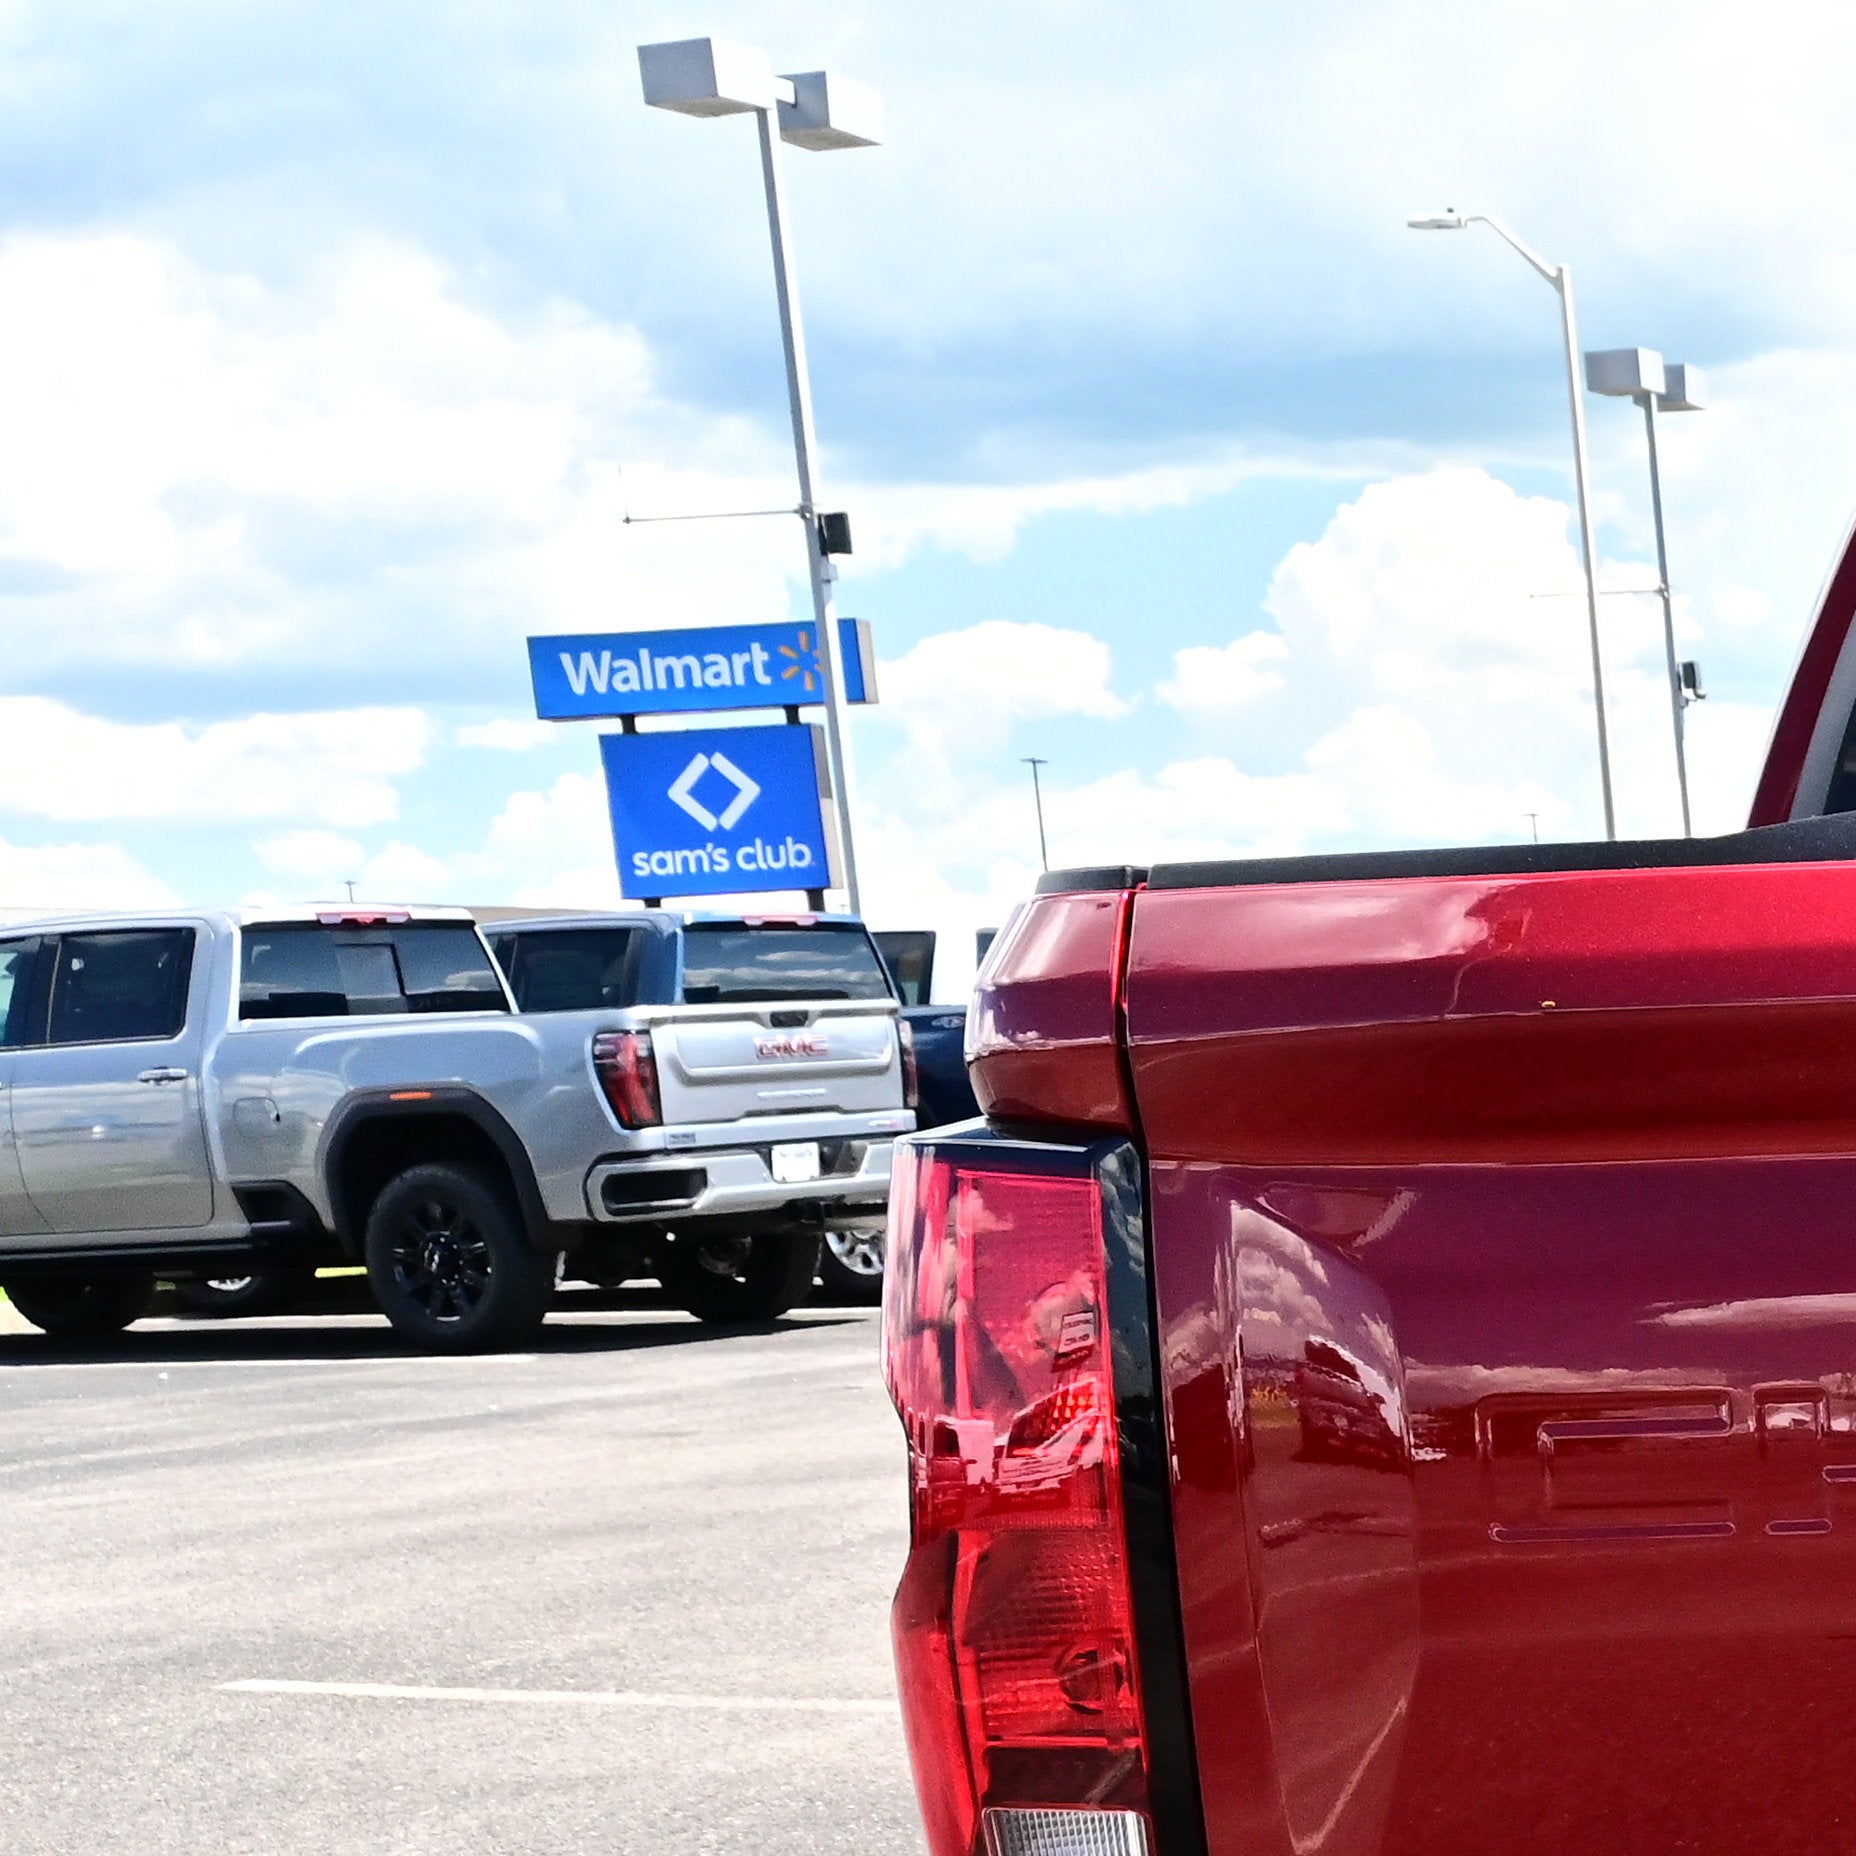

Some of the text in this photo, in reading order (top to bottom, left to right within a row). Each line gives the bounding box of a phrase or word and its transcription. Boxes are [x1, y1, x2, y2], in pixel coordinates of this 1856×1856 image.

[560, 642, 771, 695] Walmart
[633, 836, 811, 876] sam's club
